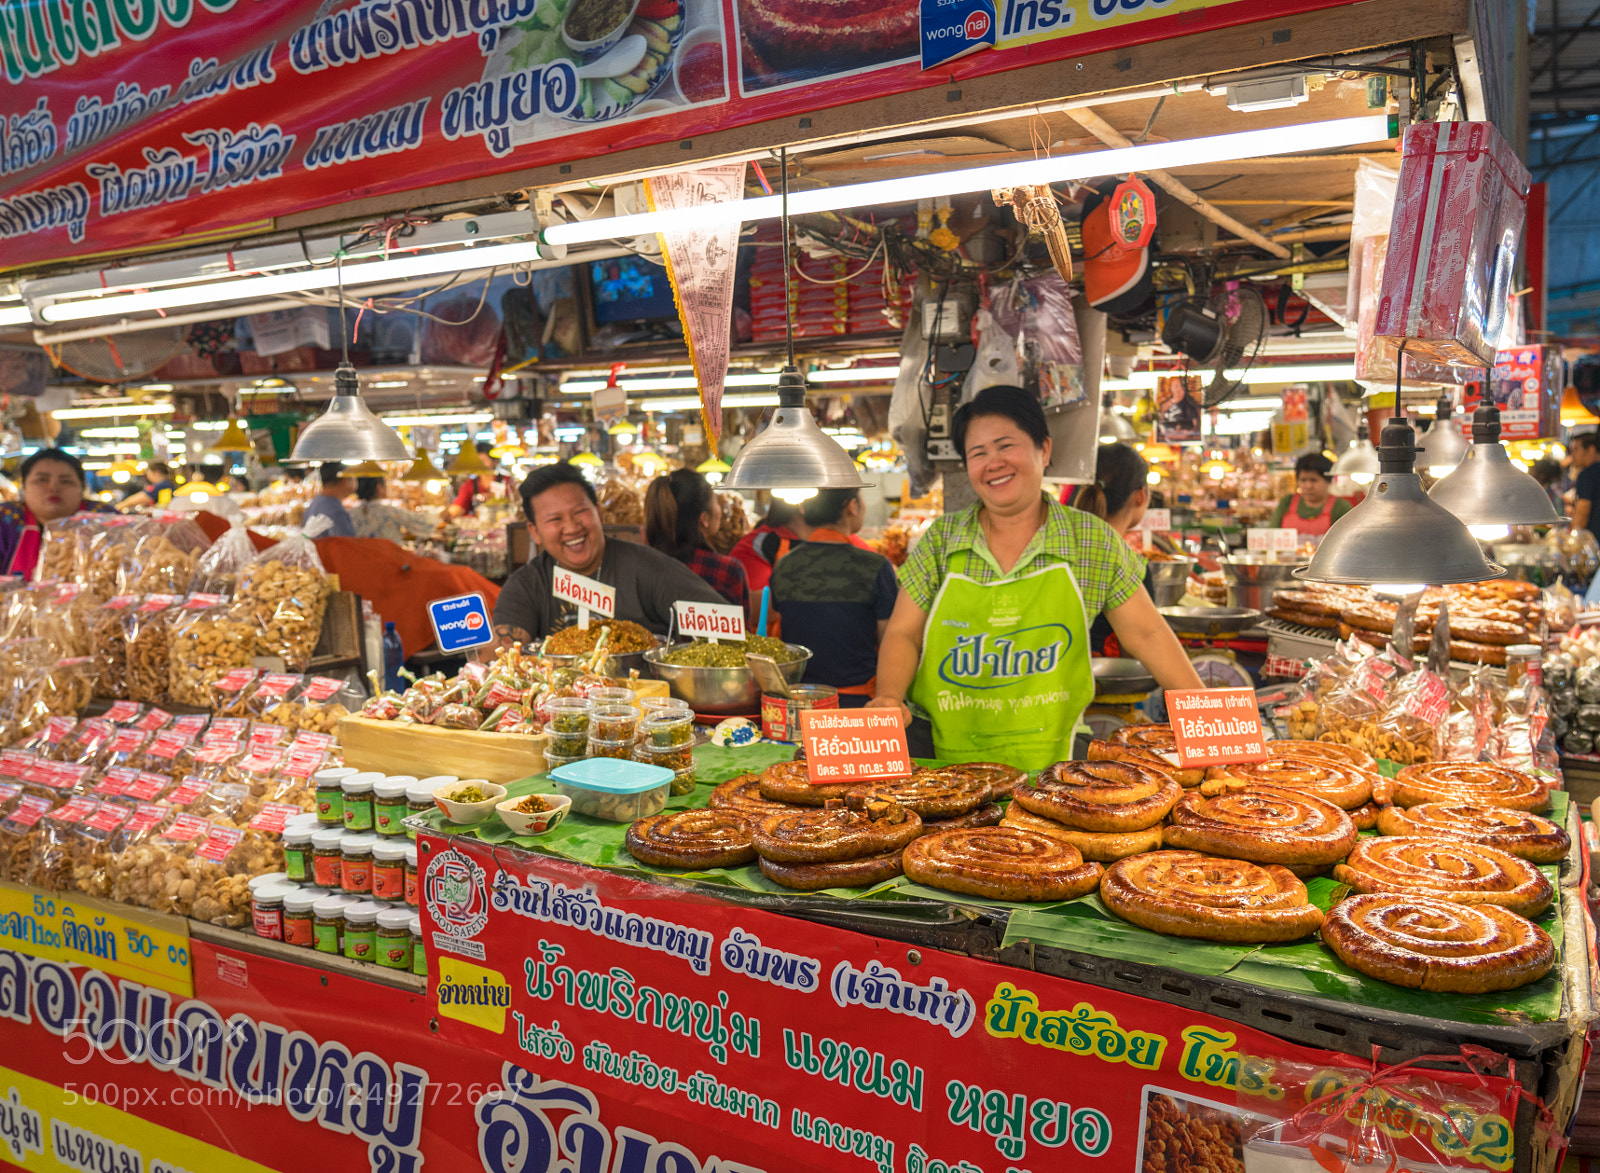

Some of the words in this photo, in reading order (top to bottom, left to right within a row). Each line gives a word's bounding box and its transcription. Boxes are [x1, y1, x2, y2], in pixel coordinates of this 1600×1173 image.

[926, 16, 987, 41] wongnai
[443, 62, 577, 155] หมูยอ
[554, 573, 613, 615] เผ็ดมาก
[679, 608, 742, 635] เผ็ดน้อย
[949, 632, 1064, 679] ฟ้าไทย
[1178, 716, 1257, 739] ไส้อั่วมันน้อย
[810, 735, 900, 757] ไส้อั่วมันมาก
[1208, 745, 1219, 757] 35
[1245, 743, 1261, 754] 350
[843, 763, 855, 774] 30
[887, 760, 904, 772] 300
[428, 904, 454, 933] FOOD
[453, 911, 487, 937] SAFETY
[438, 975, 511, 1006] จำหน่าย
[724, 931, 818, 990] อัมพร
[835, 964, 972, 1033] (เจ้าเก่า)
[524, 941, 760, 1064] น้ำพริกหนุ่ม
[784, 1029, 923, 1110] แหนม
[948, 1081, 1111, 1158] หมูยอ
[514, 1013, 573, 1062] ไส้อั่ว
[585, 1043, 778, 1127] มันน้อย-มันมาก
